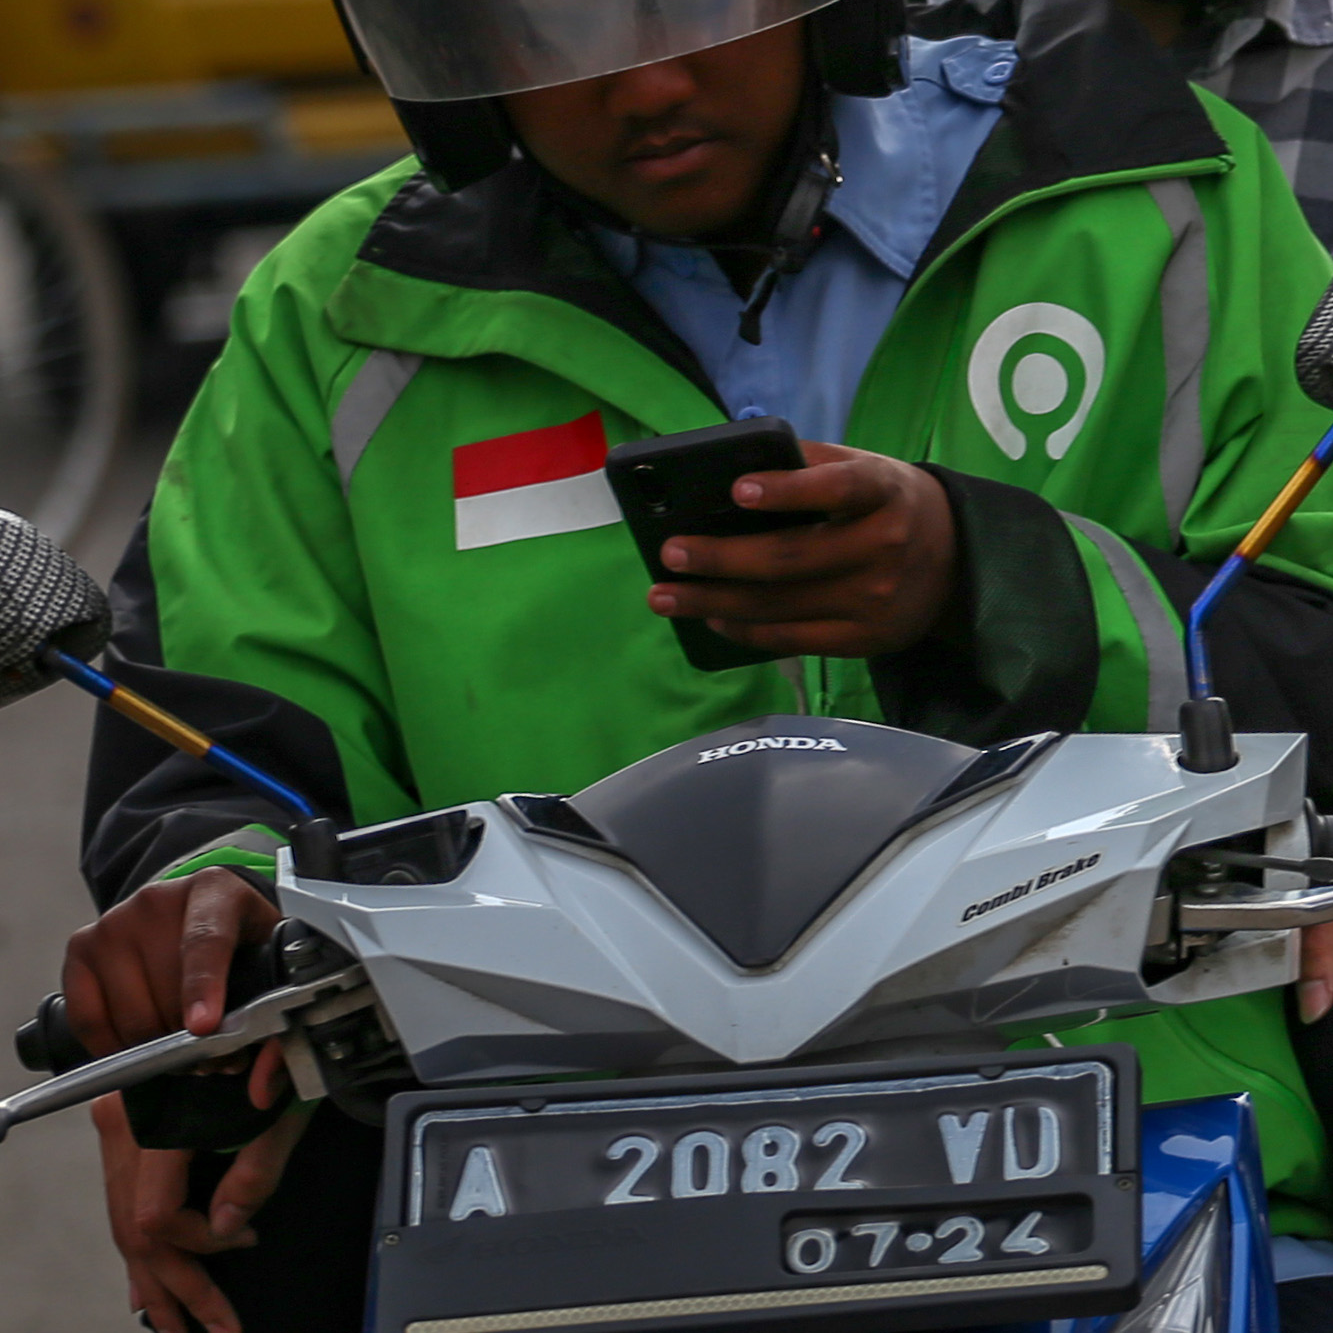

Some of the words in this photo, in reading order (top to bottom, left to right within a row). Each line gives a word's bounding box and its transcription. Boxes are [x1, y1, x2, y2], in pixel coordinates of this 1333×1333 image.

[697, 736, 848, 764] HONDA
[961, 879, 1034, 922] Combi
[1034, 852, 1102, 891] Brake
[449, 1146, 508, 1222] A
[603, 1121, 869, 1206] 2082
[937, 1105, 1061, 1185] VD
